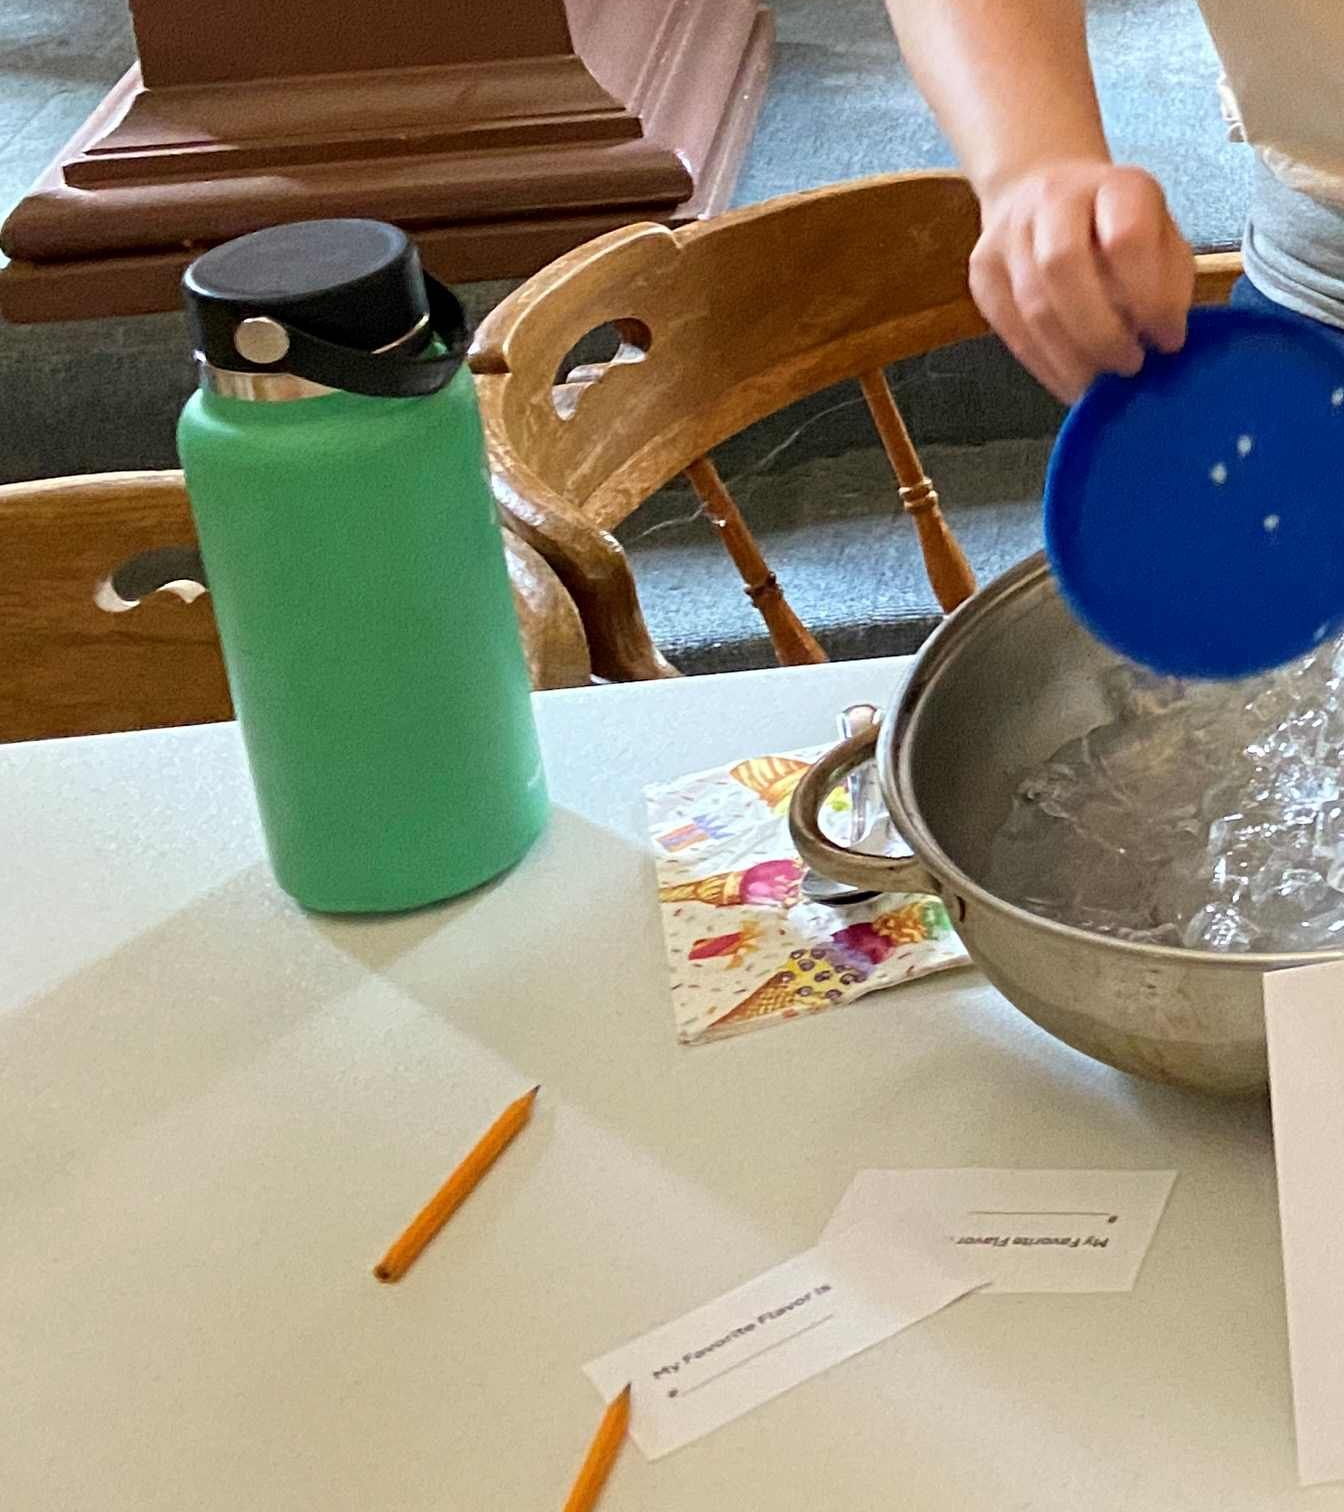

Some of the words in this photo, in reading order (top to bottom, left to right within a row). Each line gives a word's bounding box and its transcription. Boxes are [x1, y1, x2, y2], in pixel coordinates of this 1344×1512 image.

[956, 1236, 1010, 1248] Flavor
[1012, 1236, 1081, 1249] Favorite
[1082, 1235, 1110, 1249] My
[653, 1361, 681, 1379] My
[682, 1322, 756, 1364] Favorite
[757, 1292, 812, 1325] Flavor
